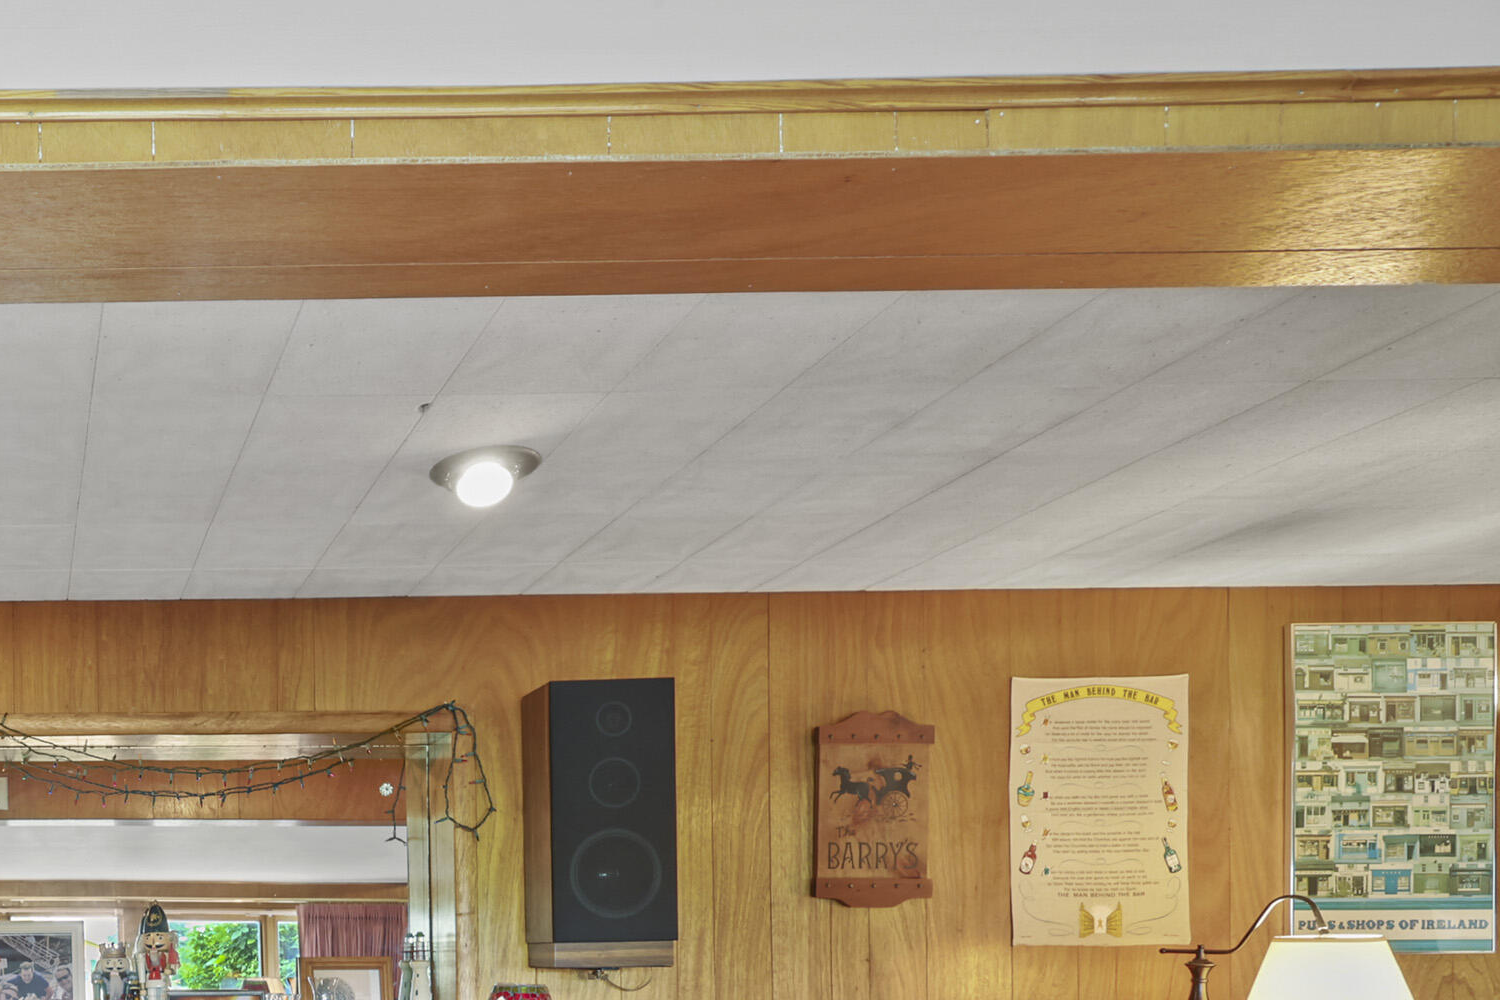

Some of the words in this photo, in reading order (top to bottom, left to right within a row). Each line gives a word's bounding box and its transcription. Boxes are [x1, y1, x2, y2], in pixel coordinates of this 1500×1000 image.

[1041, 695, 1057, 706] THE
[1063, 689, 1080, 699] MAN
[1086, 687, 1116, 696] BEHIND
[1123, 689, 1139, 700] THE
[1144, 694, 1160, 705] BAR
[827, 838, 919, 870] BARRY'S
[1298, 920, 1336, 930] PUS
[1338, 921, 1345, 929] &
[1347, 920, 1395, 930] SHOPS
[1399, 919, 1419, 930] OF
[1421, 919, 1489, 930] IRELAND
